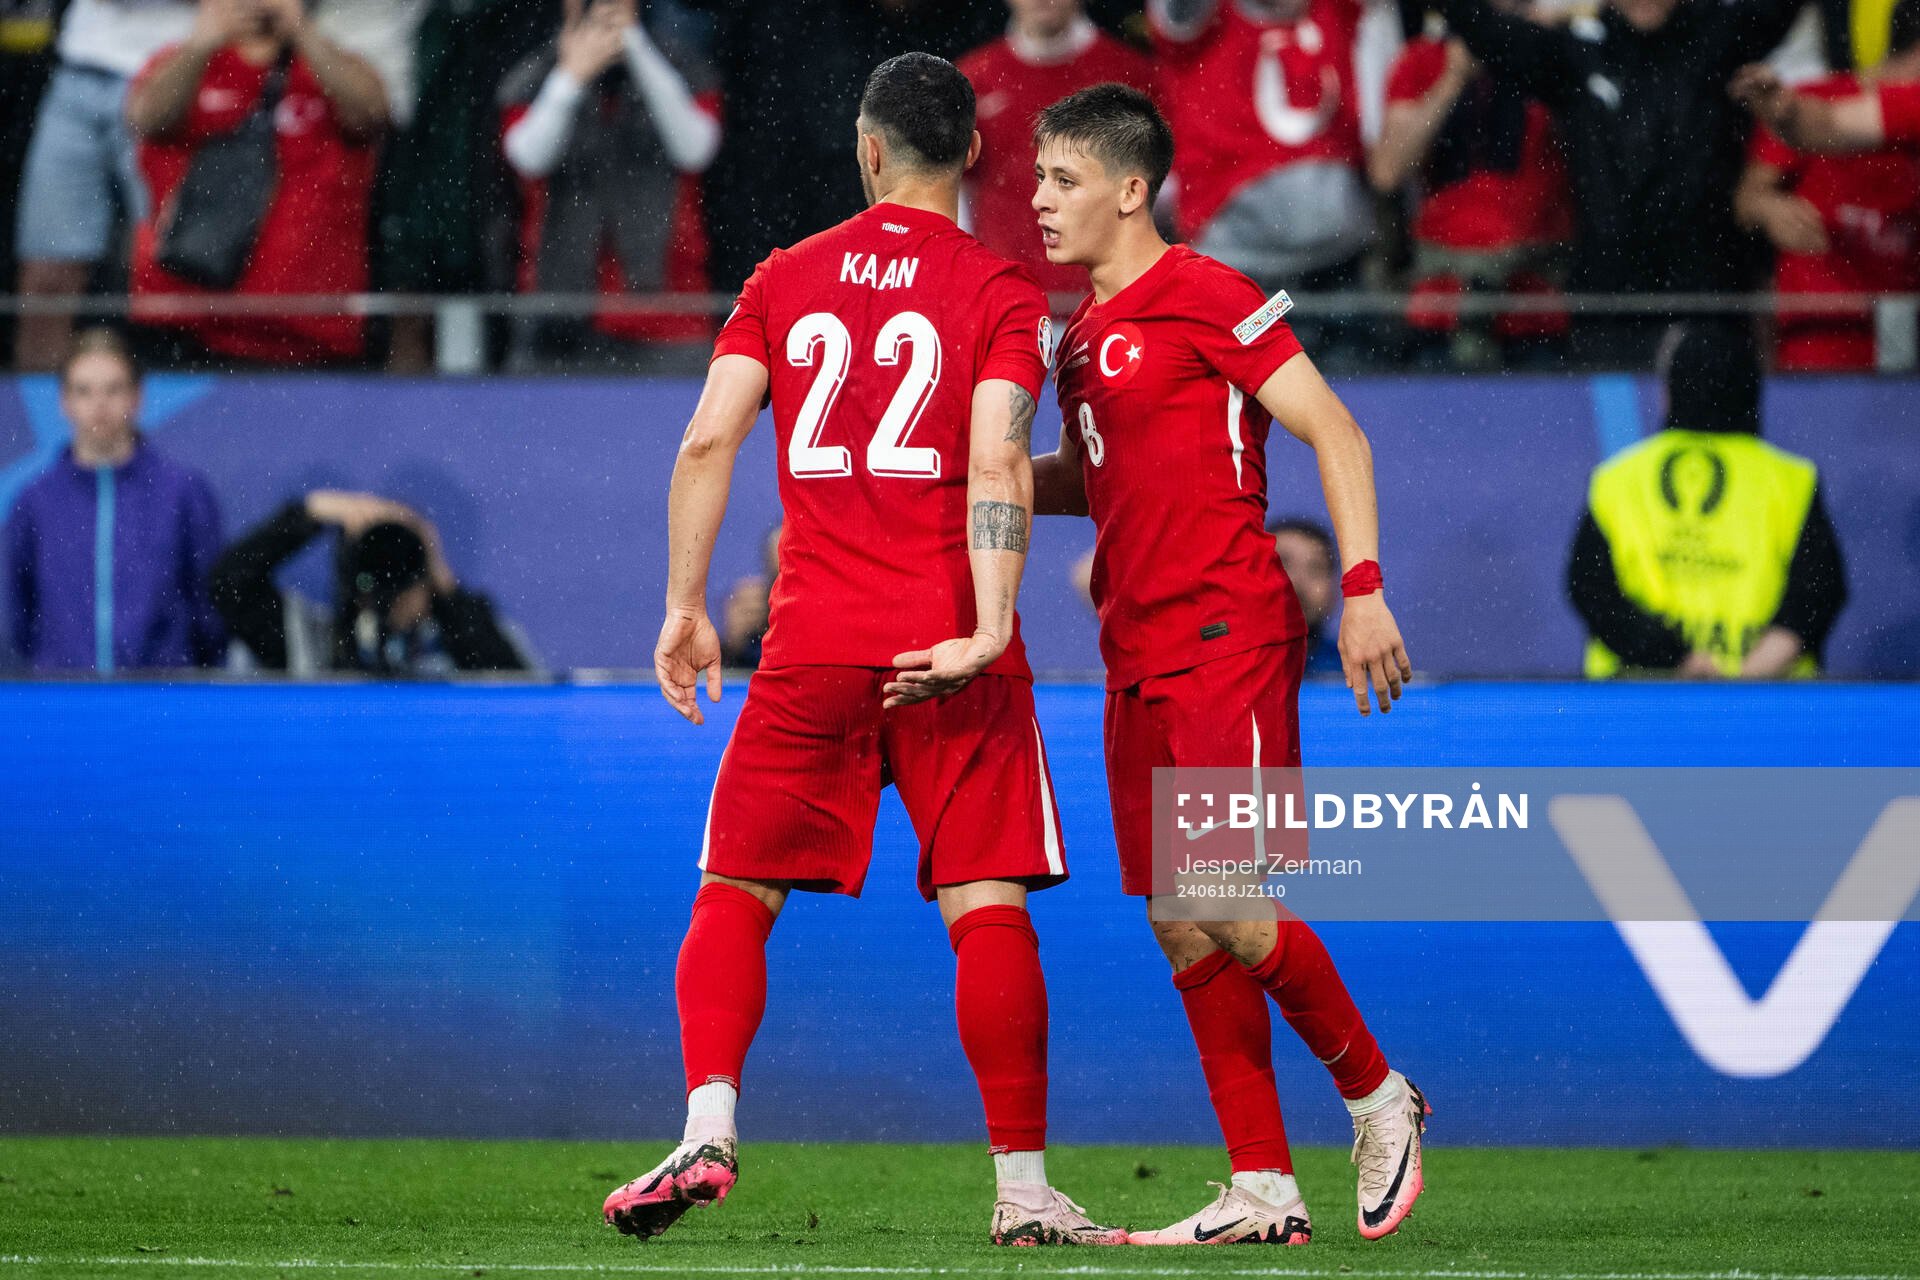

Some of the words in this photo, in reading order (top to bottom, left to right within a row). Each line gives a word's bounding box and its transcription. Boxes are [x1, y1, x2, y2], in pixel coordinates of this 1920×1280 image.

[839, 251, 920, 291] KAAN
[1237, 295, 1289, 340] FOUNDATION
[786, 310, 943, 480] 22
[1078, 402, 1106, 468] 8
